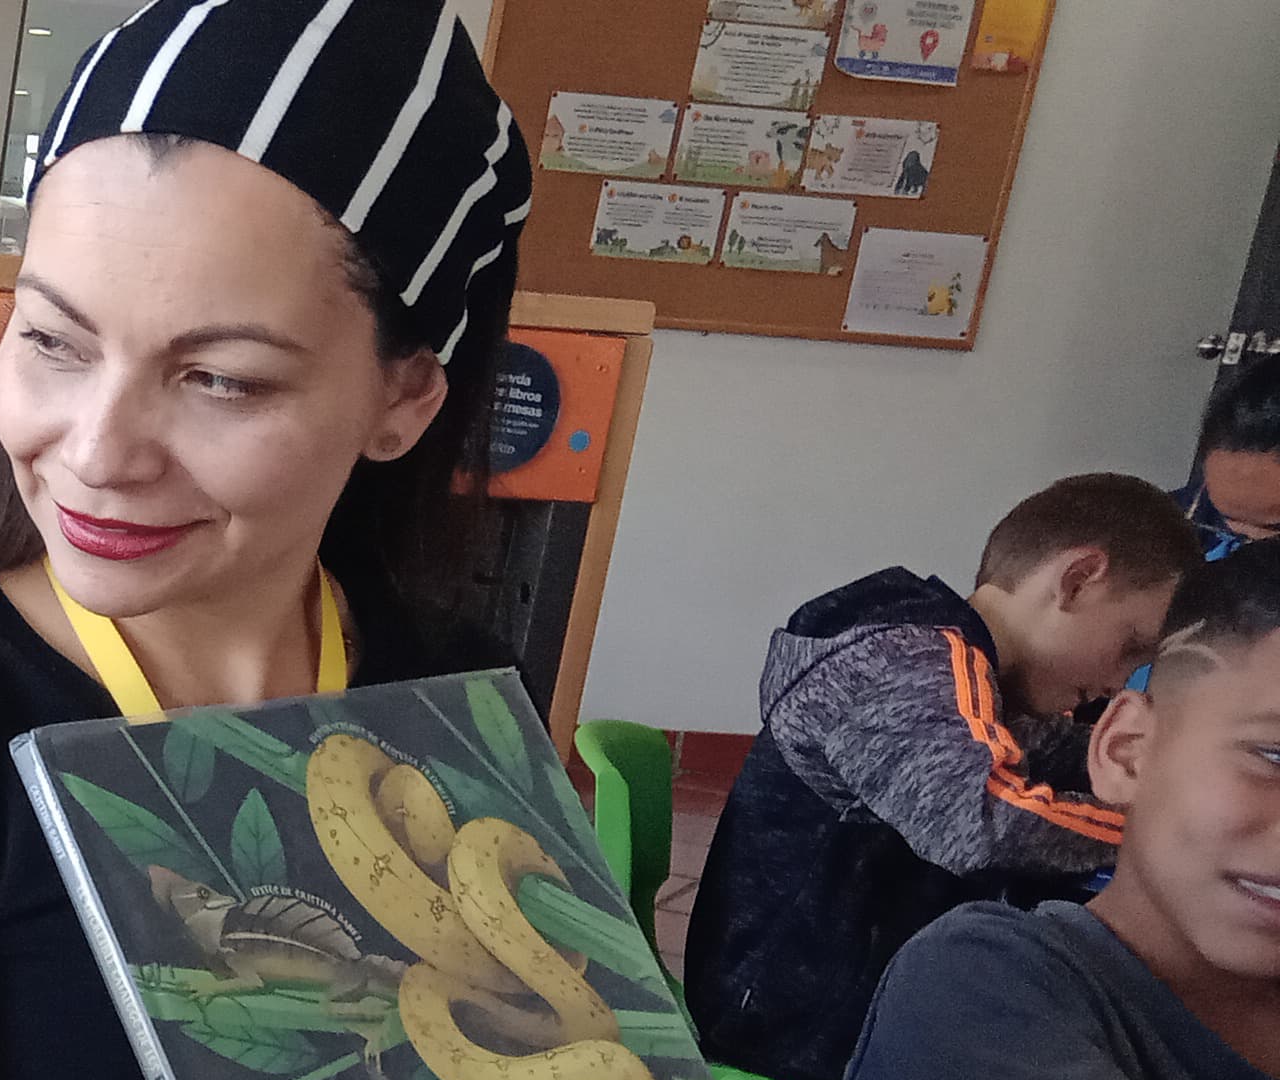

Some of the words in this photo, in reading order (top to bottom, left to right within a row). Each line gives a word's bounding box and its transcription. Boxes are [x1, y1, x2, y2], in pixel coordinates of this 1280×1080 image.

[509, 387, 542, 402] libros
[503, 404, 542, 417] mesas
[294, 888, 337, 914] CRISTINA
